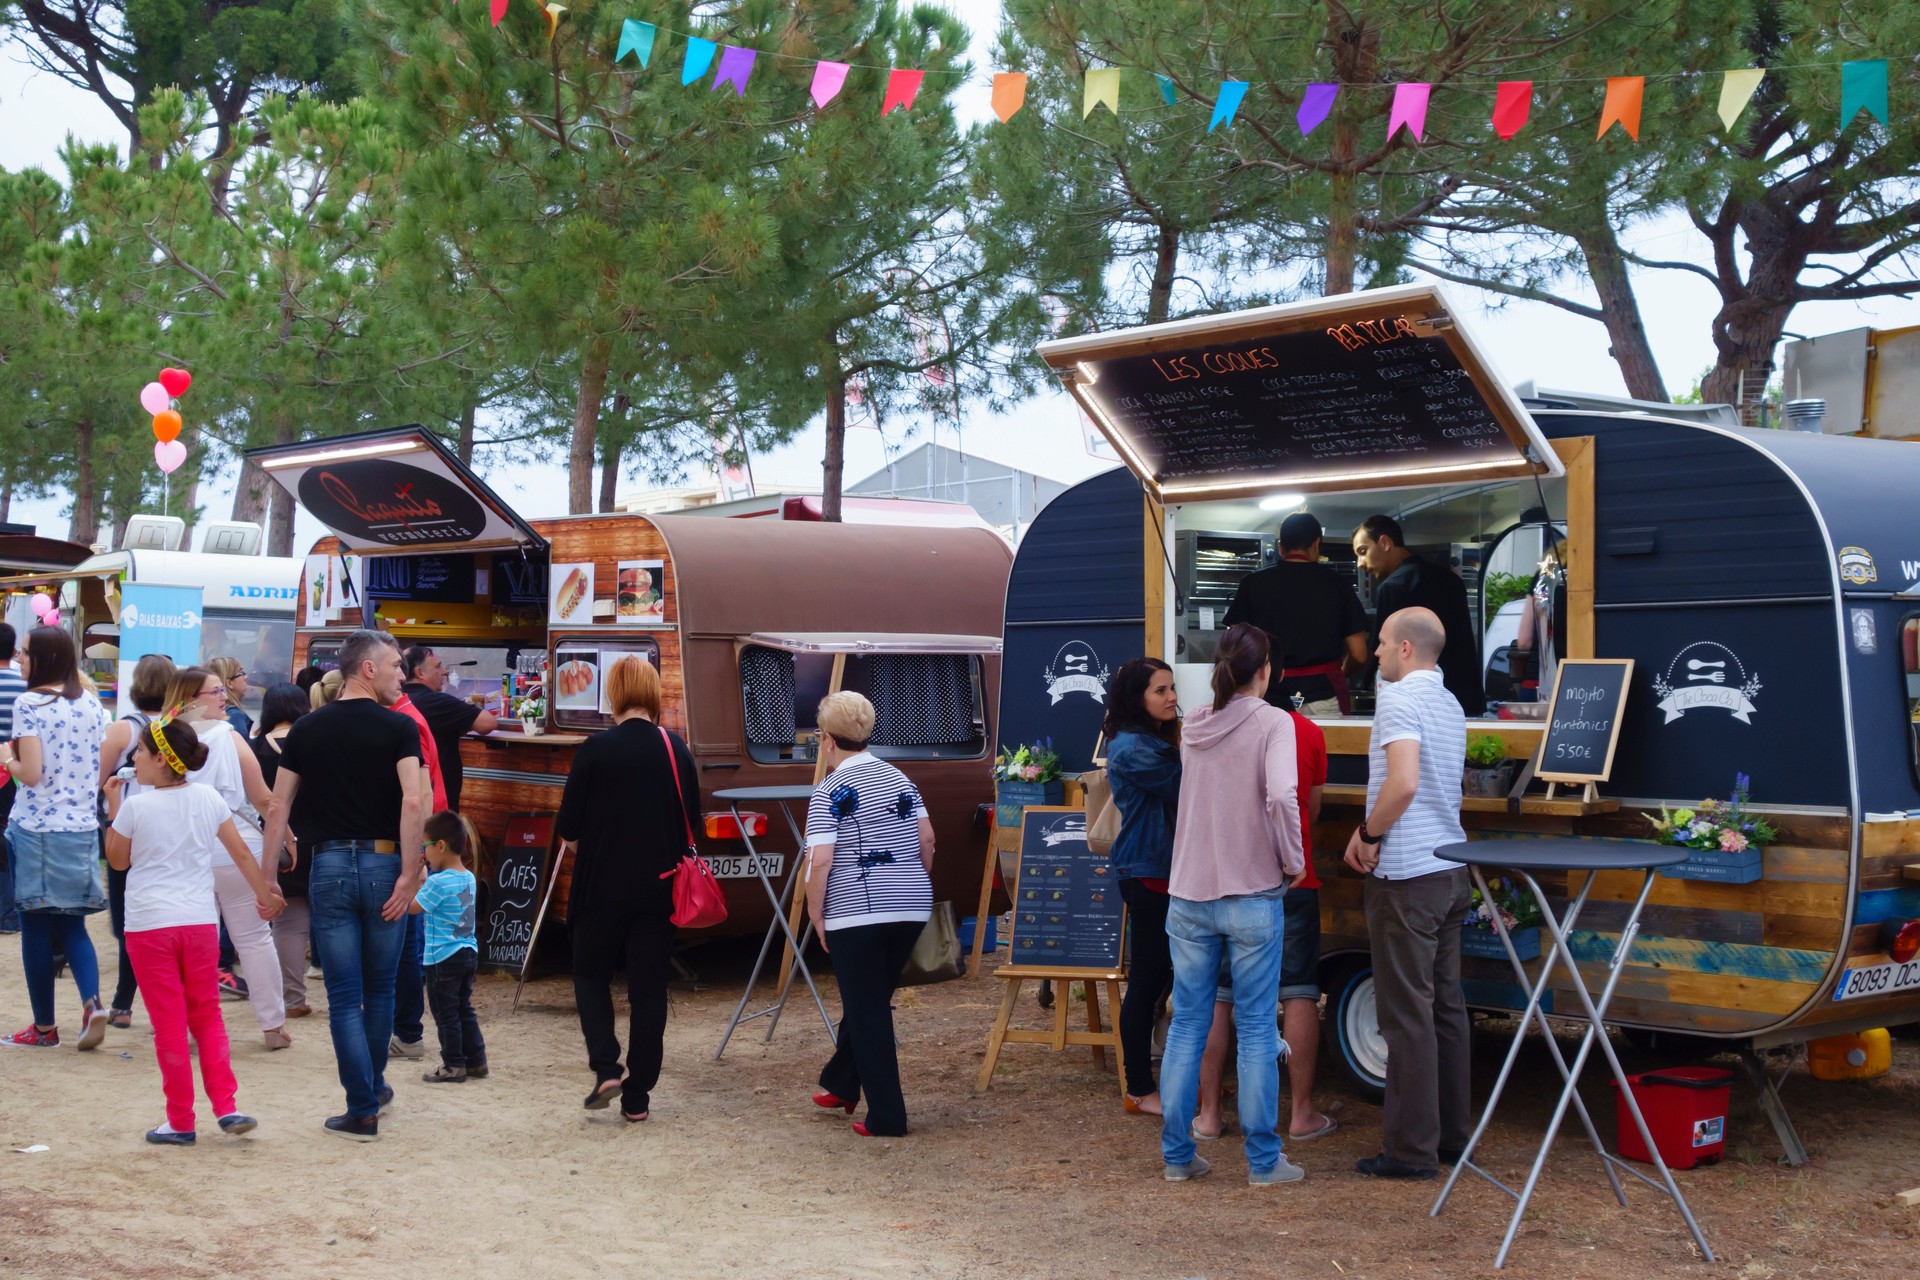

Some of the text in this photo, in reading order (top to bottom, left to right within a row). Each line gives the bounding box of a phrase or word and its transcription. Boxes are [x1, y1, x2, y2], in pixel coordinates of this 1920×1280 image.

[1326, 317, 1415, 351] PER PICAR
[1152, 347, 1279, 382] LES COQUES
[139, 612, 183, 629] RIAS BAIXAS
[1566, 685, 1606, 705] mojito
[1693, 686, 1718, 704] Coca
[1718, 688, 1734, 707] Co
[498, 855, 538, 892] CAFÉS
[486, 909, 532, 944] PASTAS
[1847, 966, 1892, 995] 8093
